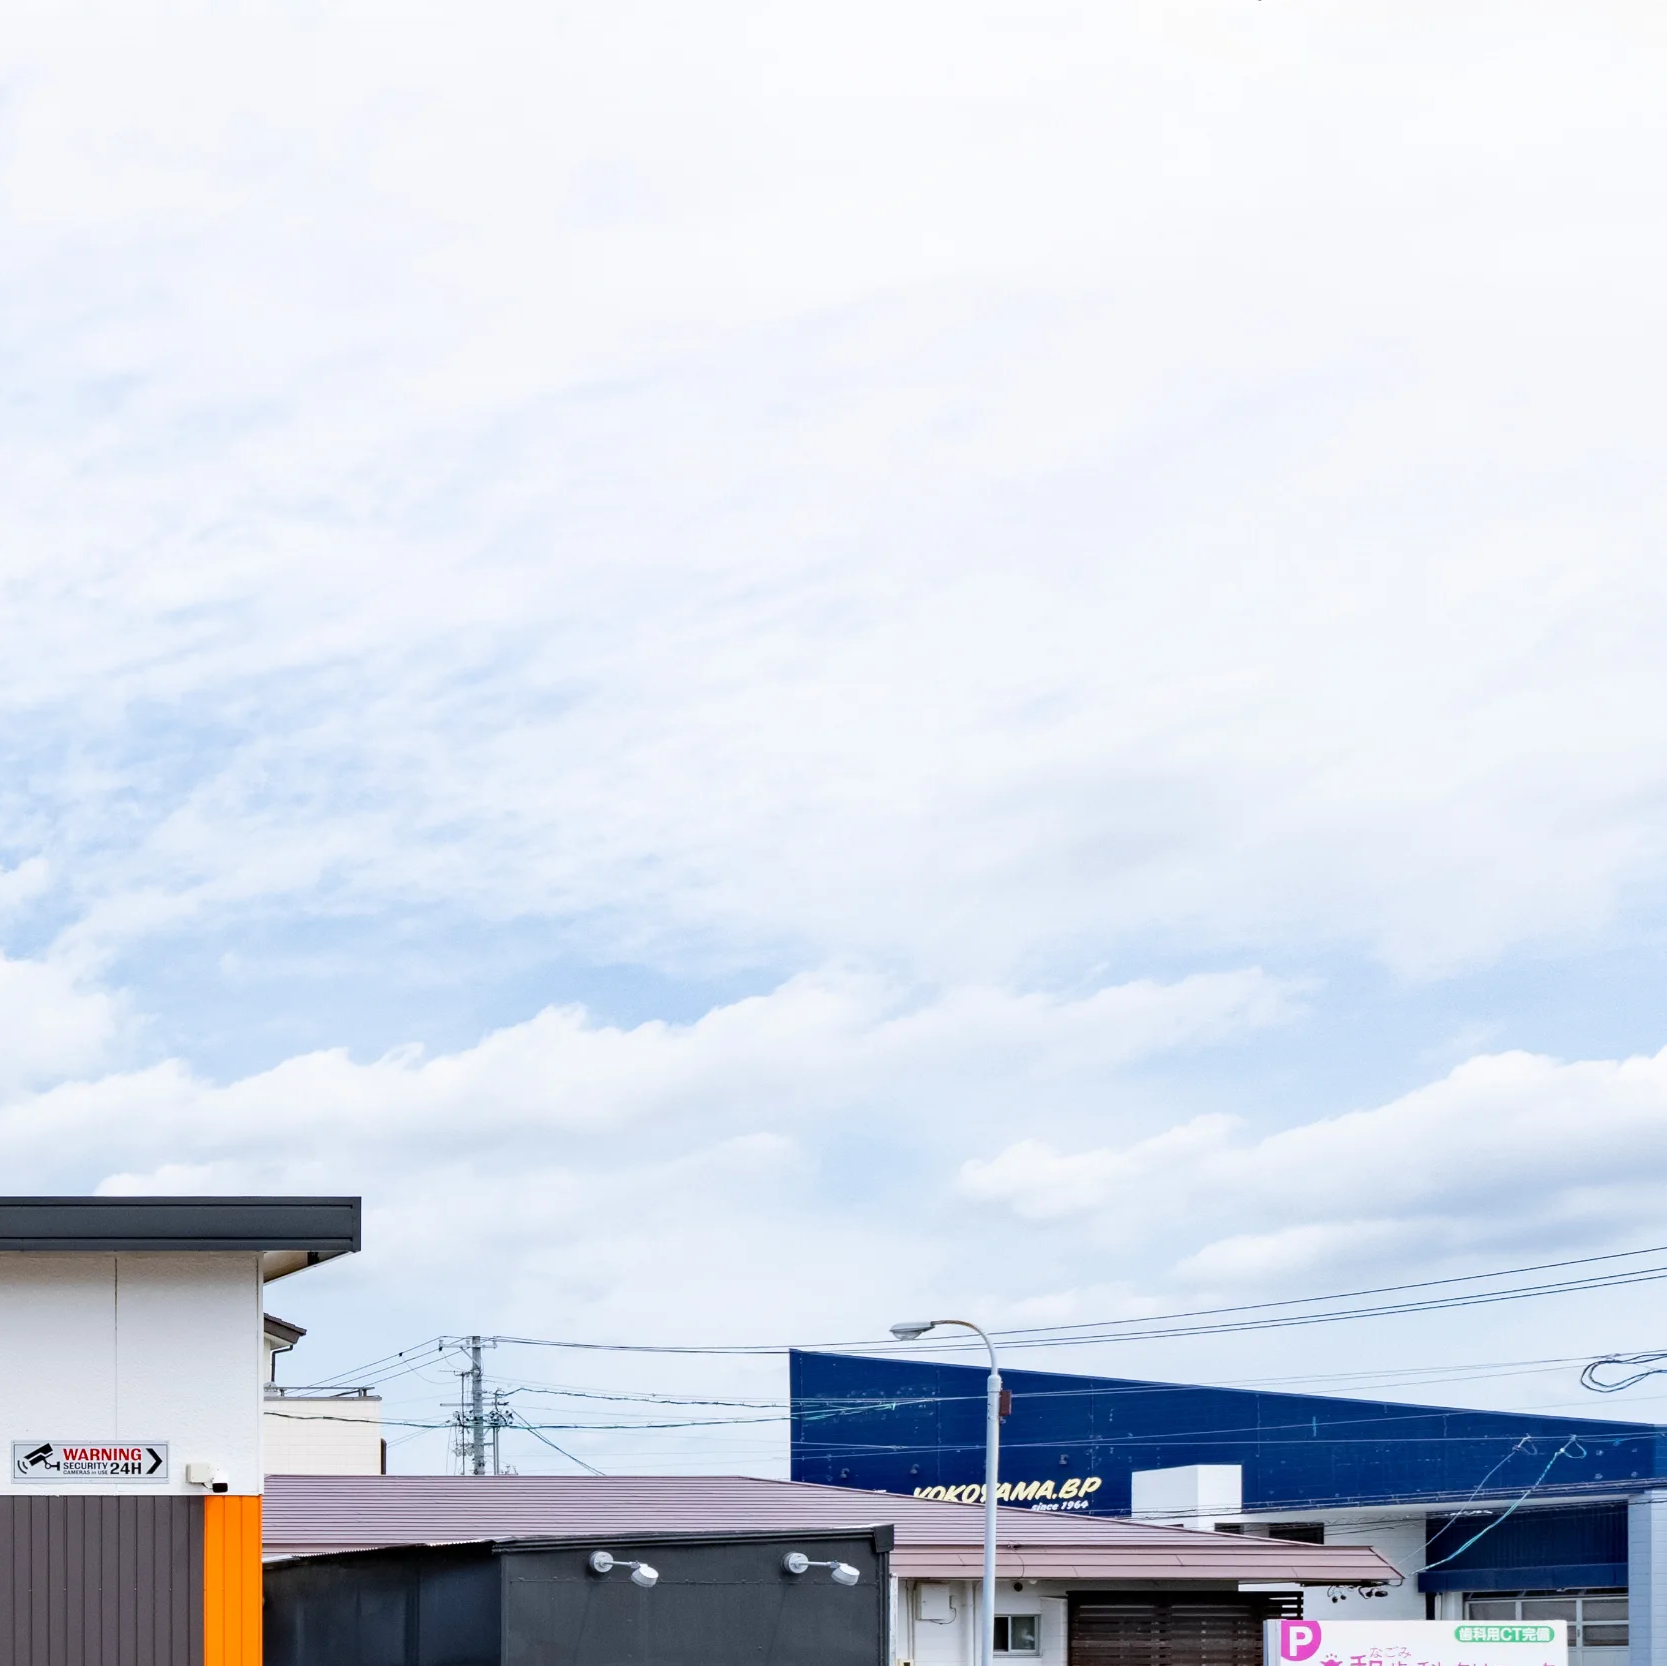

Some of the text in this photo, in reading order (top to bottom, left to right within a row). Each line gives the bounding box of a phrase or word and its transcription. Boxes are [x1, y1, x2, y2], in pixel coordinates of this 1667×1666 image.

[63, 1448, 142, 1461] WARNING
[63, 1462, 108, 1470] SECURITY
[110, 1462, 142, 1475] 24H
[1061, 1500, 1089, 1510] 1964
[1289, 1626, 1313, 1657] P
[1370, 1646, 1412, 1659] なごみ
